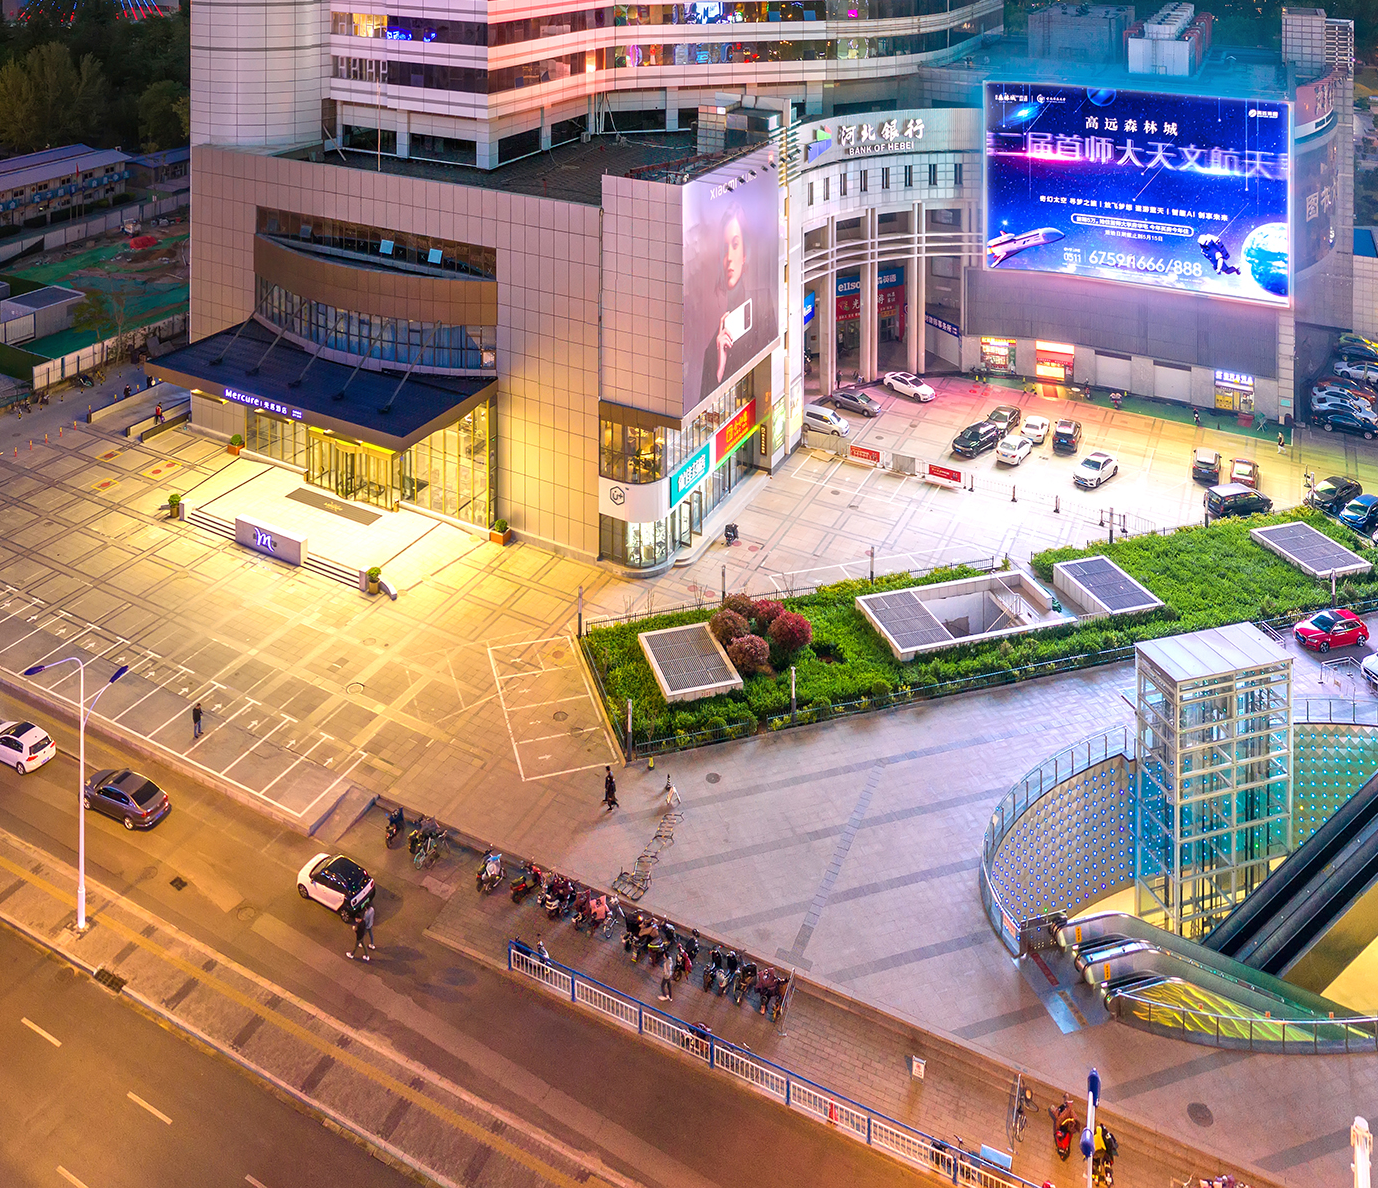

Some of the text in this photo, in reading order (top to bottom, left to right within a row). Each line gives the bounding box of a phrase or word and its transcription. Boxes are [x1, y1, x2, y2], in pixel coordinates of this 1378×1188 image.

[1085, 115, 1179, 137] 高远森林城
[849, 140, 915, 156] BANK OF HEBEI
[225, 388, 260, 406] Mercure
